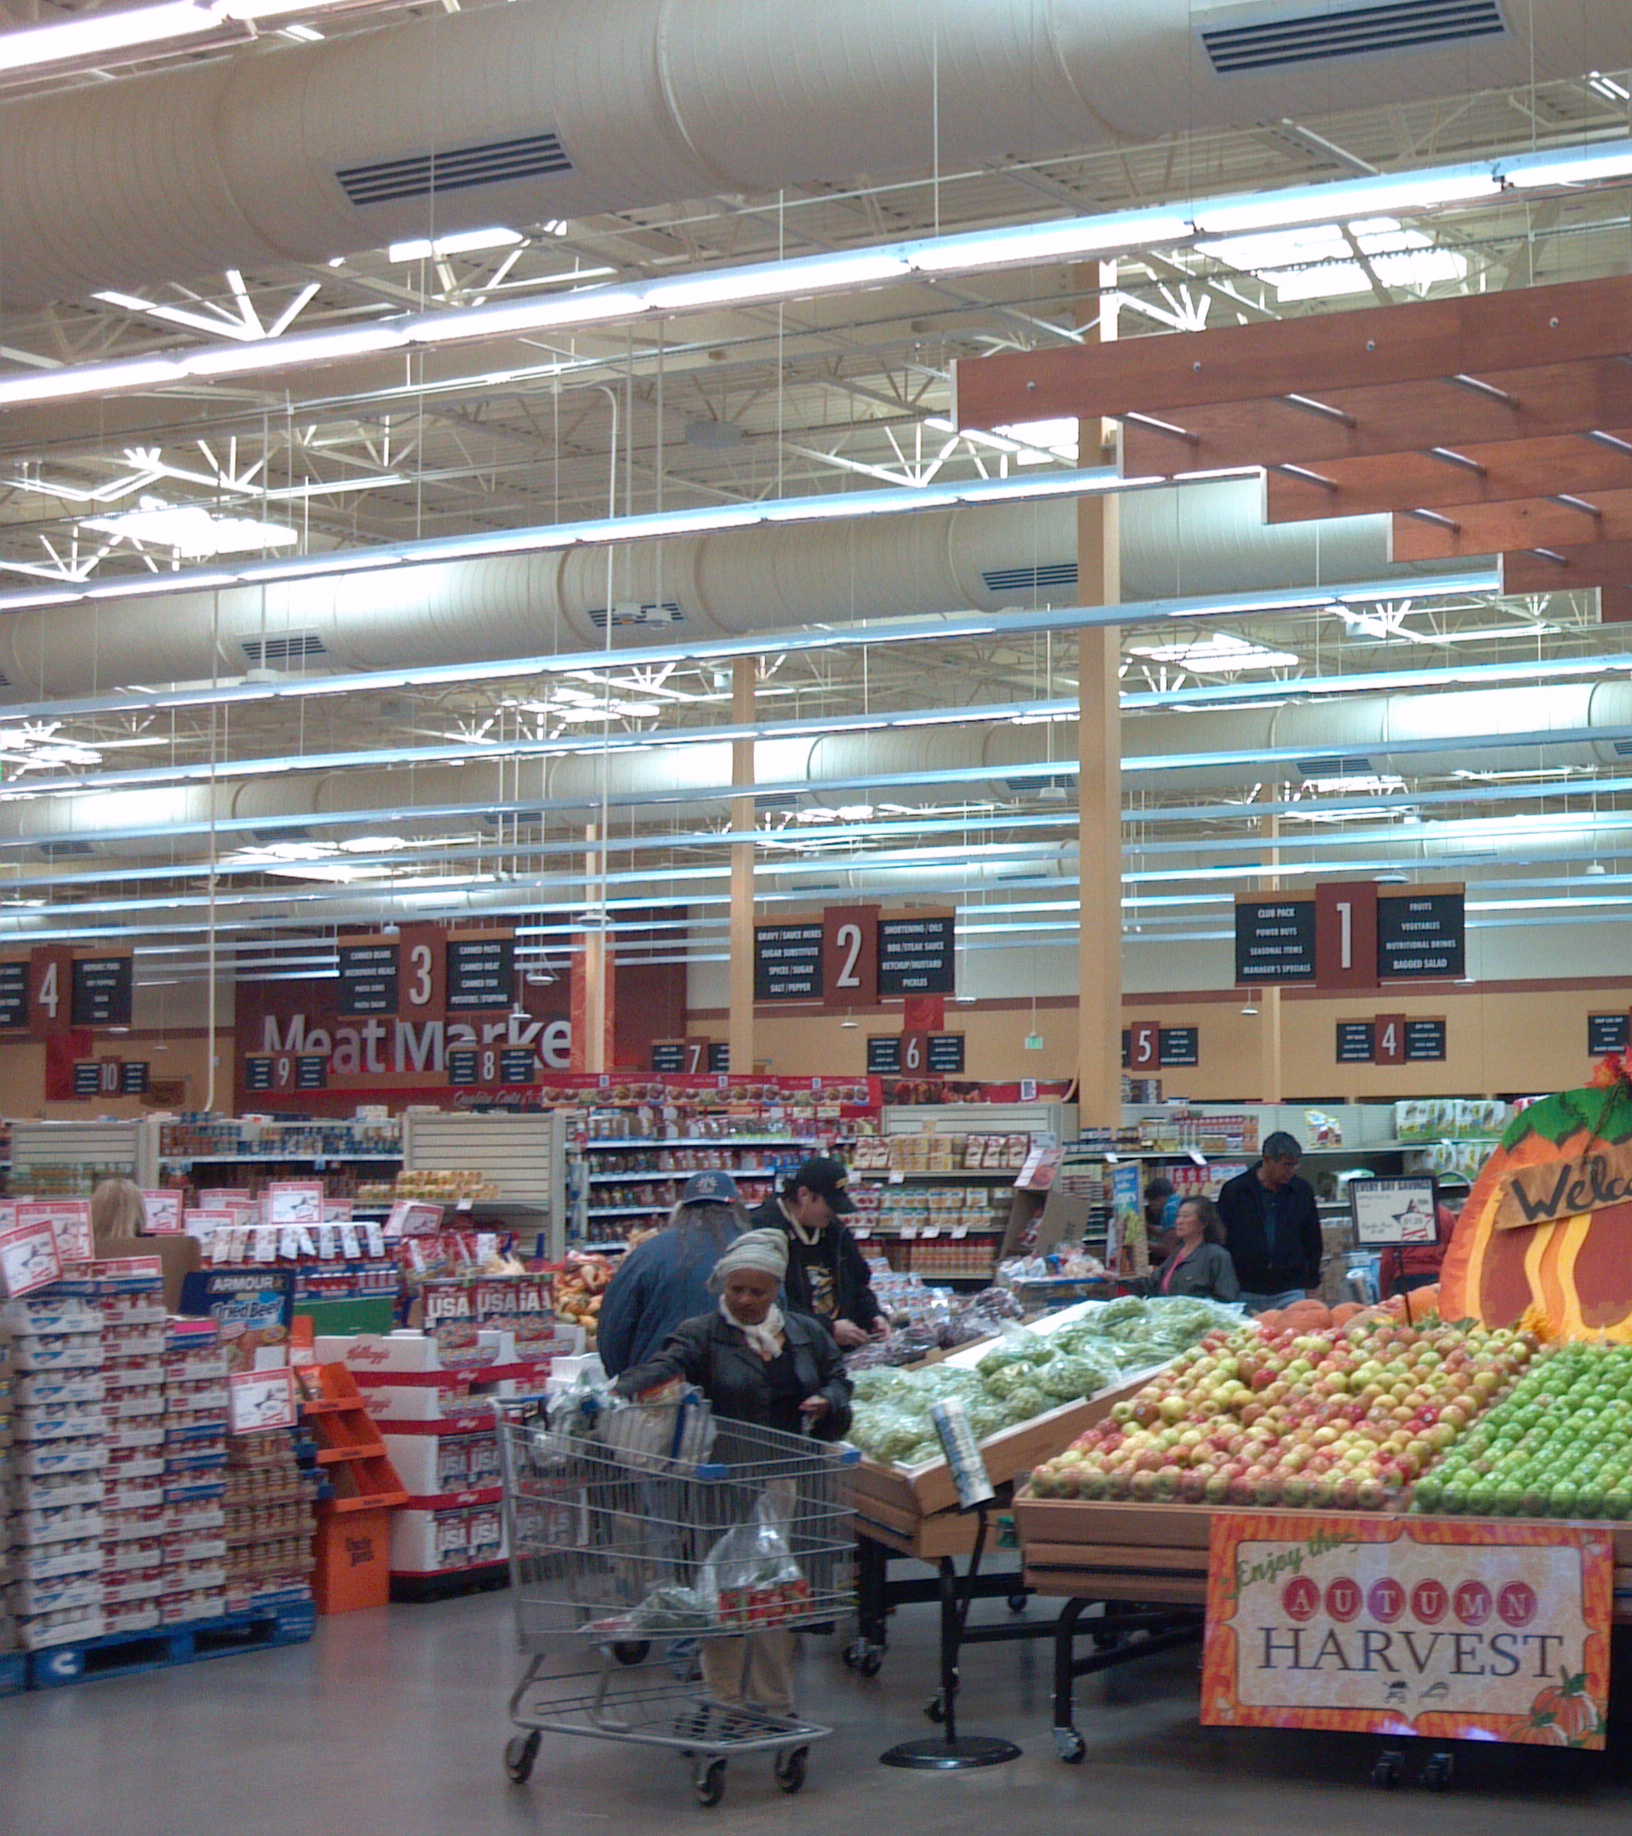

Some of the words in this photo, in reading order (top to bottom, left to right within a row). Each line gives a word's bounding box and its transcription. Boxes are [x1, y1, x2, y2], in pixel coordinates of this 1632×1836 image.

[1257, 907, 1276, 919] CLUB
[1276, 907, 1295, 918] PACK
[1409, 902, 1433, 911] FRUITS
[1255, 927, 1279, 937] POWER
[1280, 926, 1298, 936] BUYS
[1336, 902, 1351, 969] 1
[1401, 920, 1440, 931] VEGETABLES
[836, 923, 862, 988] 2
[1249, 946, 1283, 956] SEASONAL
[1283, 945, 1303, 955] ITEMS
[1385, 941, 1430, 951] NUTRITIONAL
[1431, 939, 1456, 949] DRINKS
[410, 945, 432, 1005] 3
[1243, 965, 1281, 975] MANAGER'S
[1282, 964, 1311, 974] SPECIALS
[1392, 959, 1423, 970] BAGGED
[1424, 958, 1448, 969] SALAD
[39, 962, 59, 1018] 4
[902, 978, 928, 988] PICKLES
[263, 1014, 386, 1074] Meat
[395, 1015, 572, 1073] Marke
[906, 1038, 920, 1069] 6
[1138, 1030, 1152, 1062] 5
[1382, 1023, 1396, 1056] 4
[278, 1057, 290, 1086] 9
[483, 1051, 495, 1080] 8
[689, 1045, 701, 1074] 7
[102, 1063, 118, 1091] 10
[211, 1276, 274, 1291] ARMOUR
[248, 1296, 286, 1318] Beef
[428, 1297, 471, 1318] USA
[477, 1293, 518, 1313] USA
[438, 1528, 468, 1550] USA
[1226, 1547, 1305, 1597] Enjoy
[1306, 1528, 1352, 1557] the
[1288, 1584, 1532, 1621] AUTUMN
[1257, 1626, 1564, 1678] HARVEST
